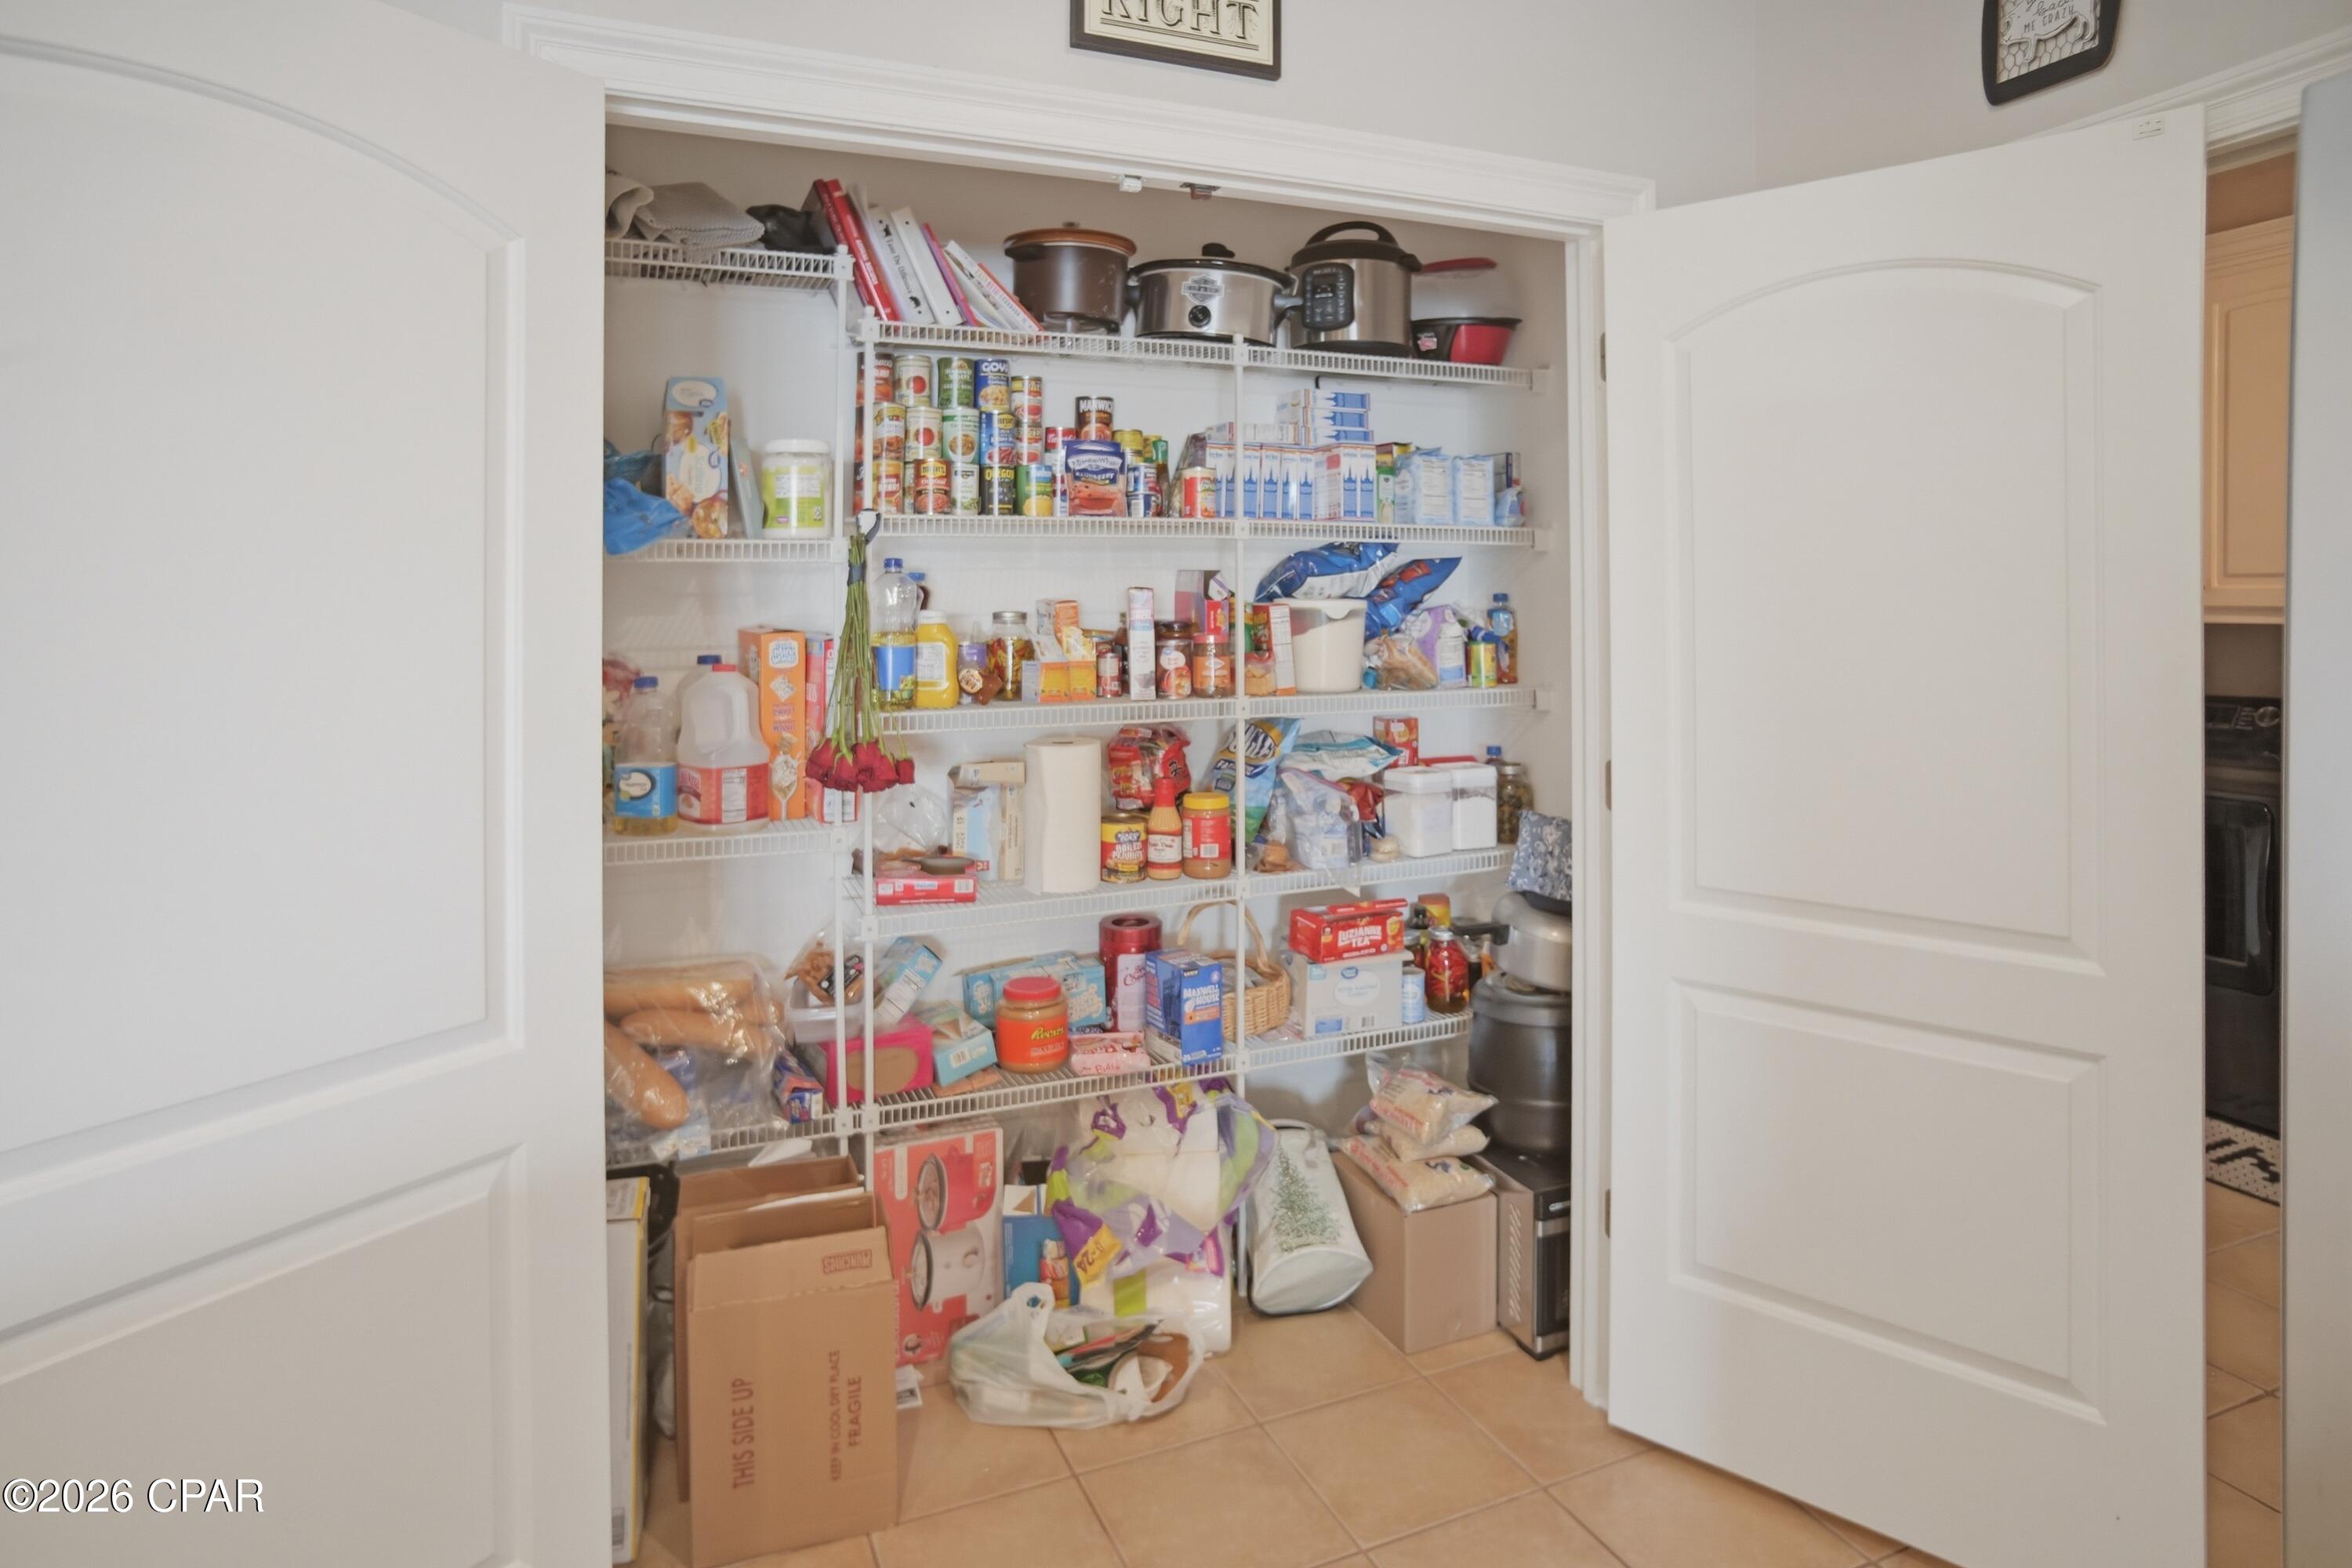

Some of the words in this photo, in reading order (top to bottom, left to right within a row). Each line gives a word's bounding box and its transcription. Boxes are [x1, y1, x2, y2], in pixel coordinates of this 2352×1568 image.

[2024, 20, 2036, 33] ME
[1338, 925, 1382, 944] LUZIANNE
[1352, 937, 1370, 947] TEA
[1183, 985, 1220, 999] MAXWELL
[1196, 992, 1220, 1004] HOUSE
[829, 1350, 840, 1384] PLACE
[731, 1377, 754, 1403] UP
[829, 1386, 840, 1406] DRY
[848, 1376, 862, 1447] FRAGILE
[731, 1406, 755, 1446] SIDE
[829, 1407, 841, 1440] COOL
[731, 1450, 756, 1490] THIS
